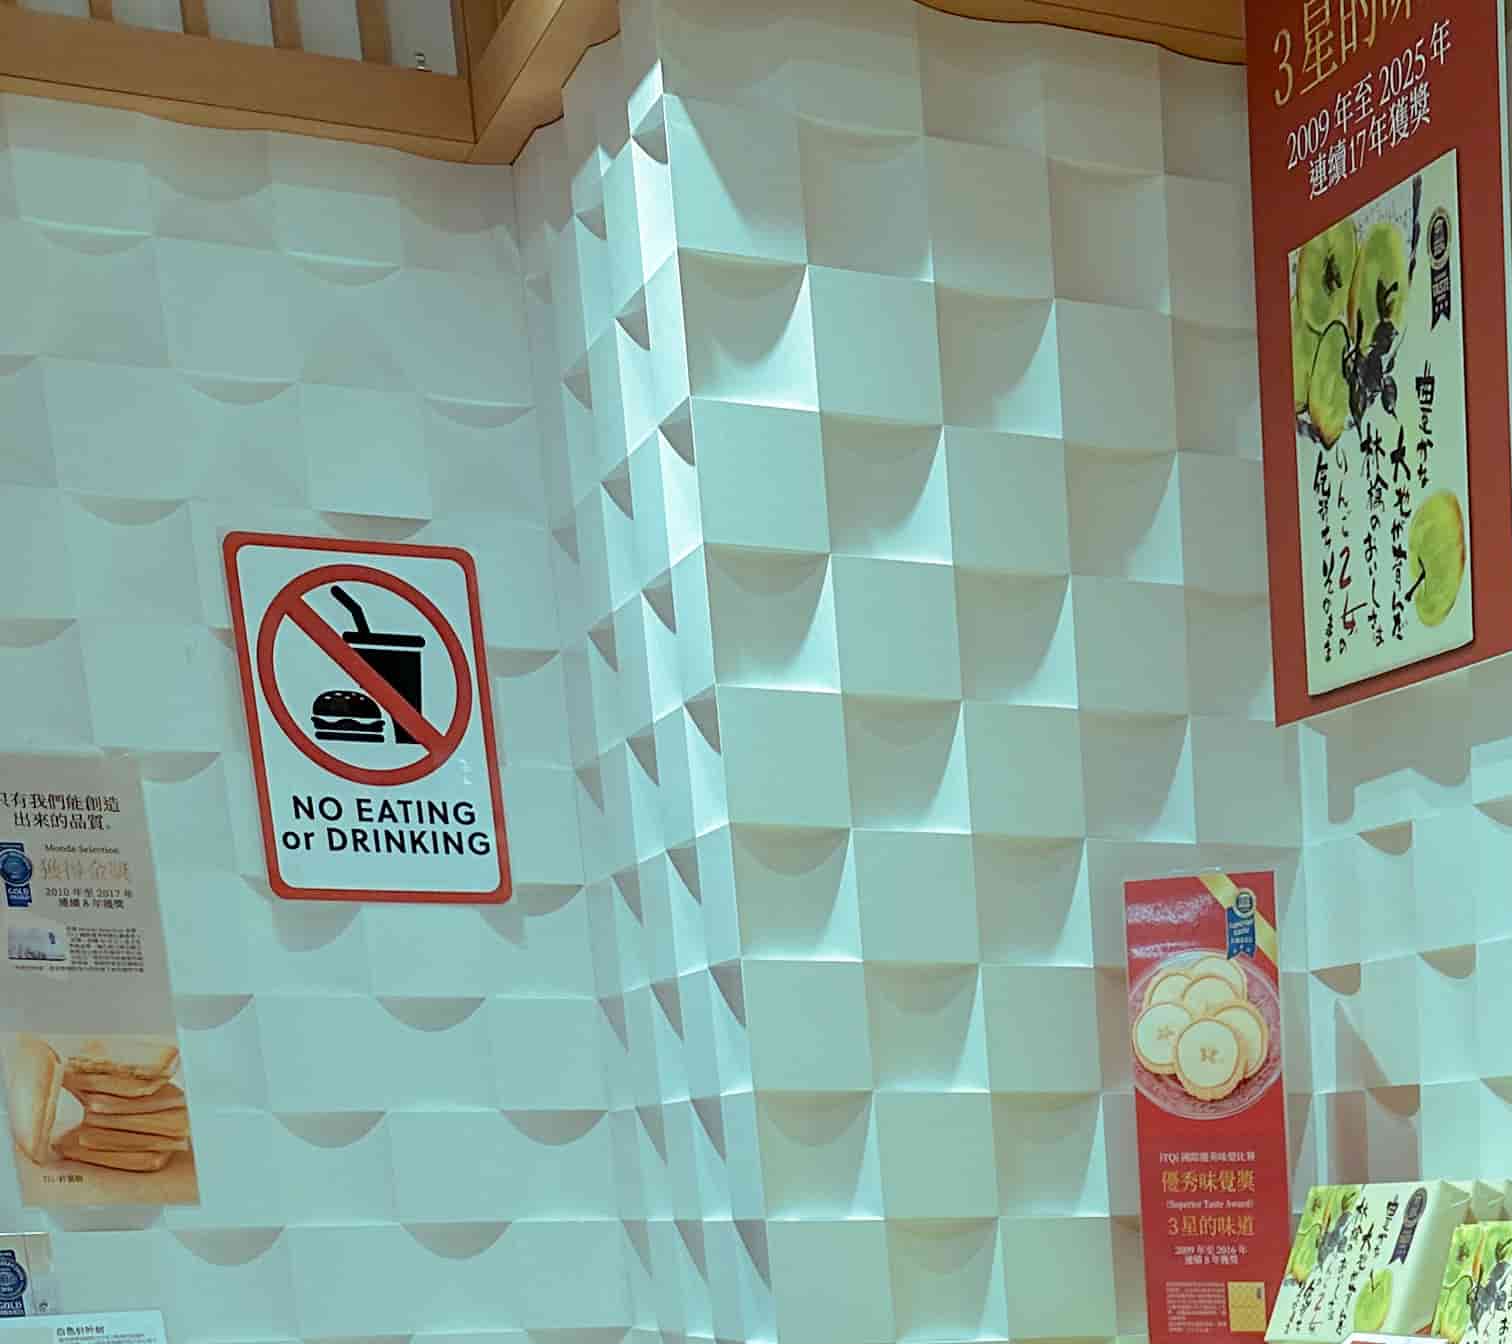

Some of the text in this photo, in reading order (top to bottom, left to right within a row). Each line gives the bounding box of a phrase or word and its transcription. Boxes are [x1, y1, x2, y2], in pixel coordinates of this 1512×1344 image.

[1274, 0, 1411, 105] 3星的
[1287, 110, 1330, 170] 2009
[1379, 39, 1425, 107] 2025
[1430, 19, 1451, 65] 年
[281, 826, 491, 856] or DRINKING
[292, 794, 478, 826] NO EATING
